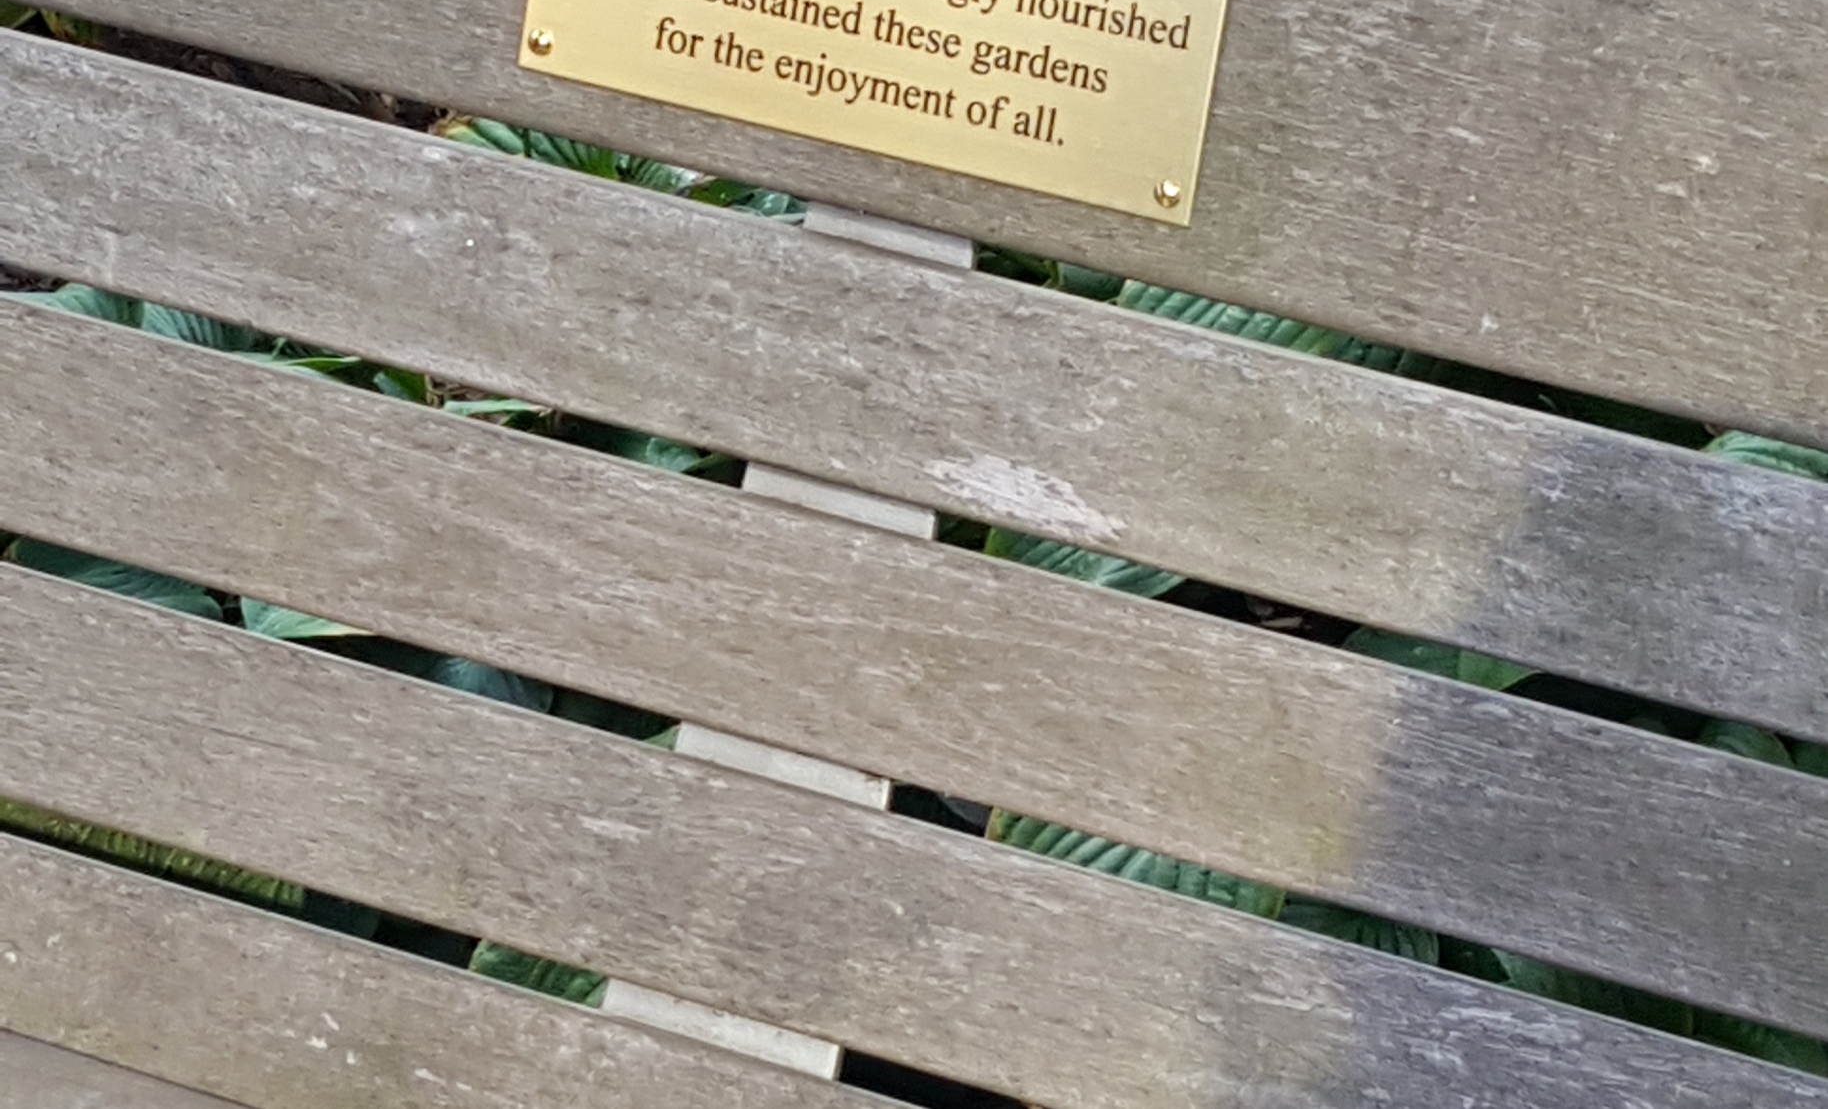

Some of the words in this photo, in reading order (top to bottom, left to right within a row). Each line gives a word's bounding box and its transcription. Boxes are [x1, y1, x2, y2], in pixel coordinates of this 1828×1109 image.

[655, 16, 705, 58] for
[713, 31, 765, 73] the
[774, 52, 957, 119] enjoyment
[965, 95, 1011, 130] of
[1012, 104, 1064, 147] all.
[873, 8, 962, 59] these
[969, 40, 1108, 94] gardens
